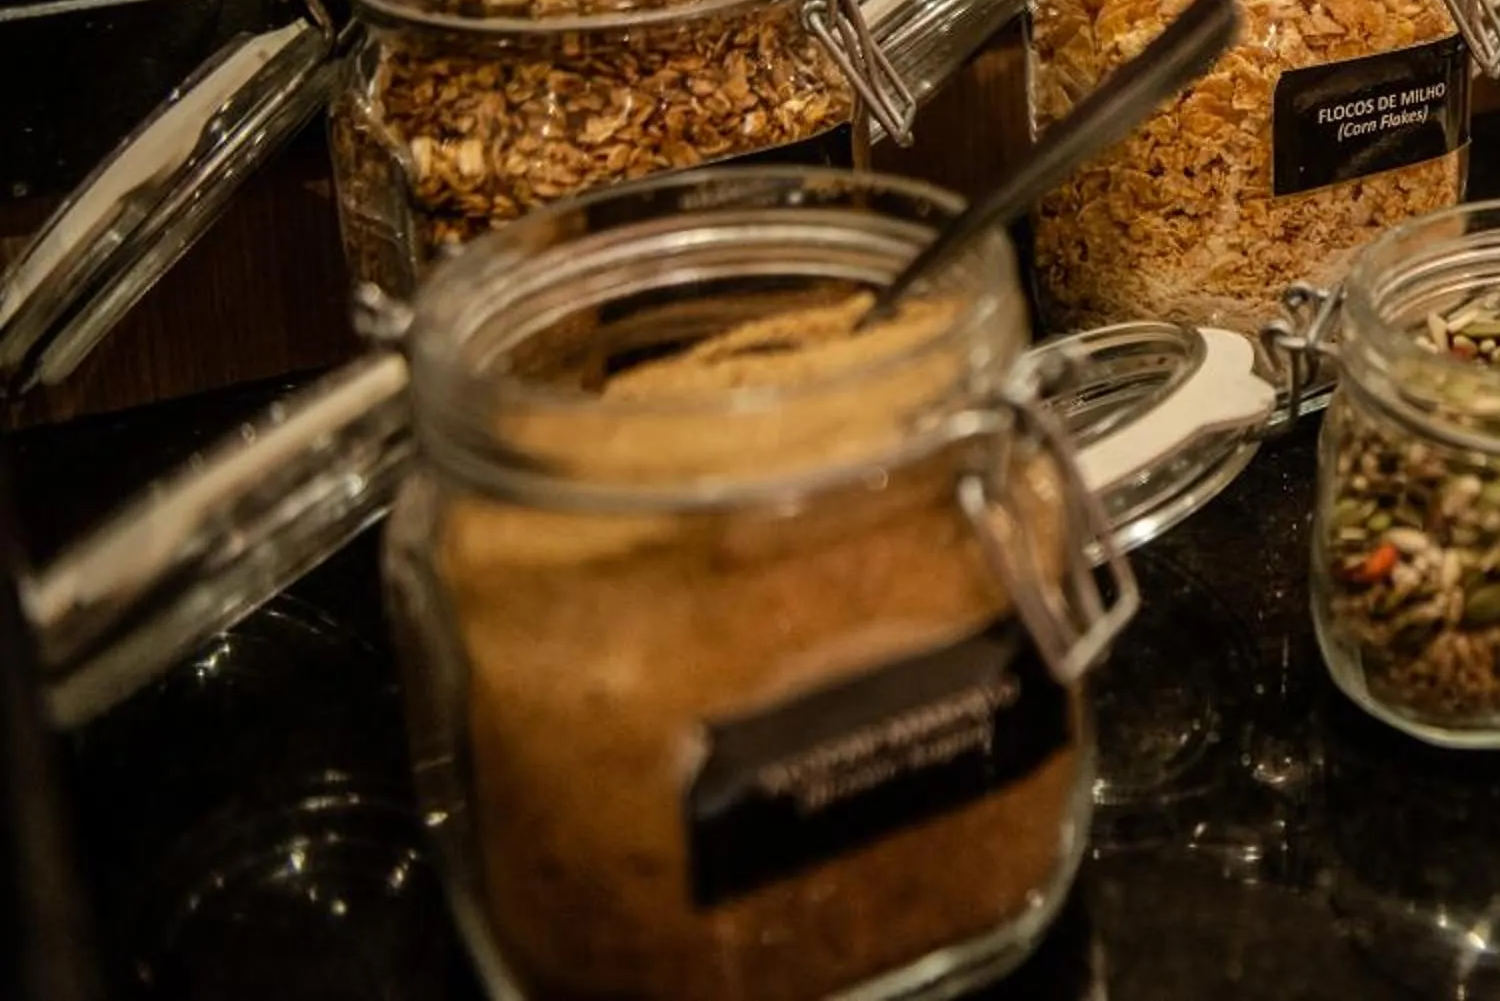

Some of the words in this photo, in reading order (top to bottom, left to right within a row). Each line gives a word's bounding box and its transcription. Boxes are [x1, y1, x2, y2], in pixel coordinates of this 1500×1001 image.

[1318, 98, 1375, 124] FLOCOS
[1377, 94, 1397, 111] DE
[1401, 82, 1446, 106] MILHO
[1337, 117, 1377, 143] (Corn
[1379, 104, 1430, 131] Flakes)
